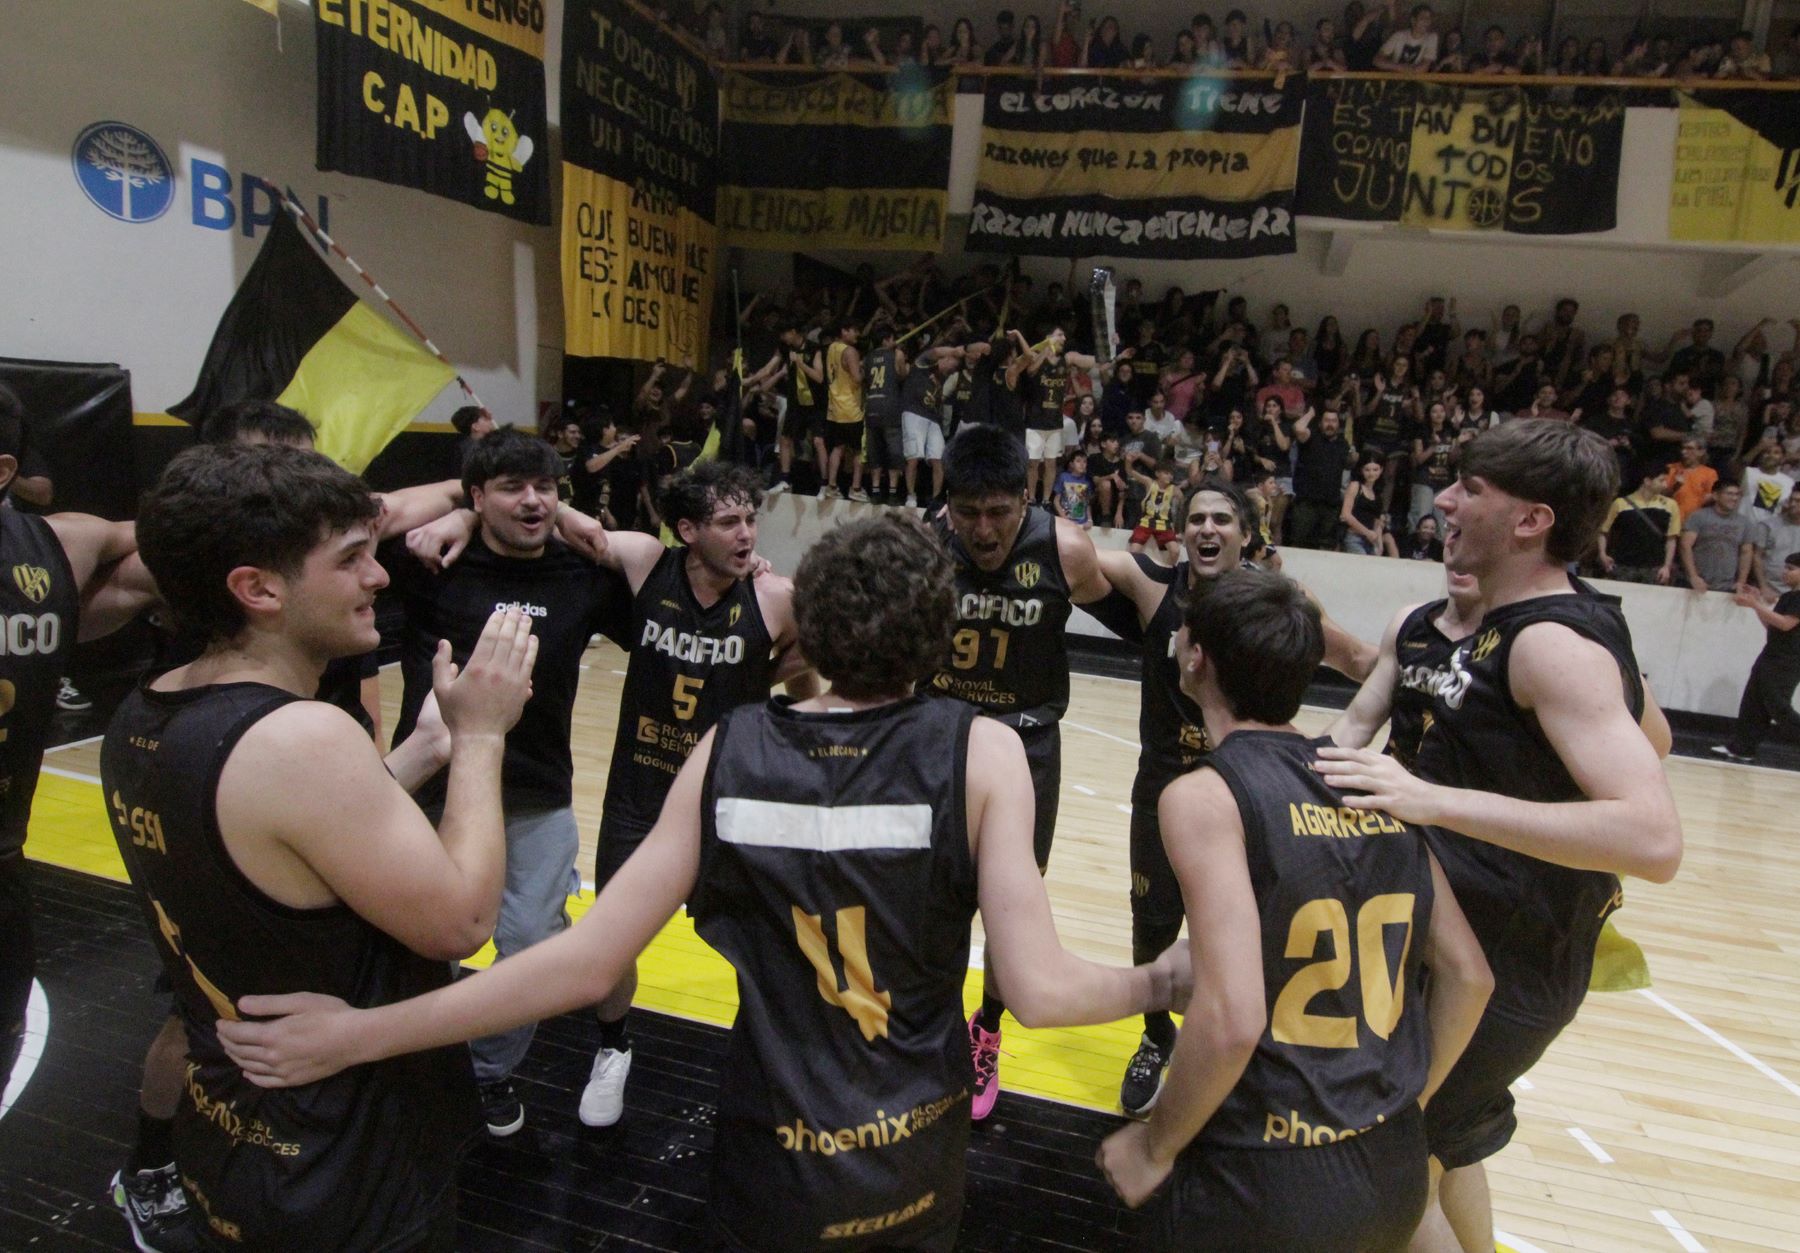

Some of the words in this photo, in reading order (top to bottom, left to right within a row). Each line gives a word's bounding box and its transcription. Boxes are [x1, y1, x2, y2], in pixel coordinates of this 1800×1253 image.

[317, 0, 497, 91] ETERNIDAD
[1332, 131, 1411, 171] COMO
[1333, 104, 1372, 127] ES
[1392, 104, 1454, 135] TAN
[1473, 114, 1595, 166] BUENO
[1436, 144, 1554, 183] TODOS
[869, 365, 886, 390] 24
[952, 627, 1010, 670] 91
[672, 672, 705, 722] 5
[1270, 893, 1416, 1048] 20
